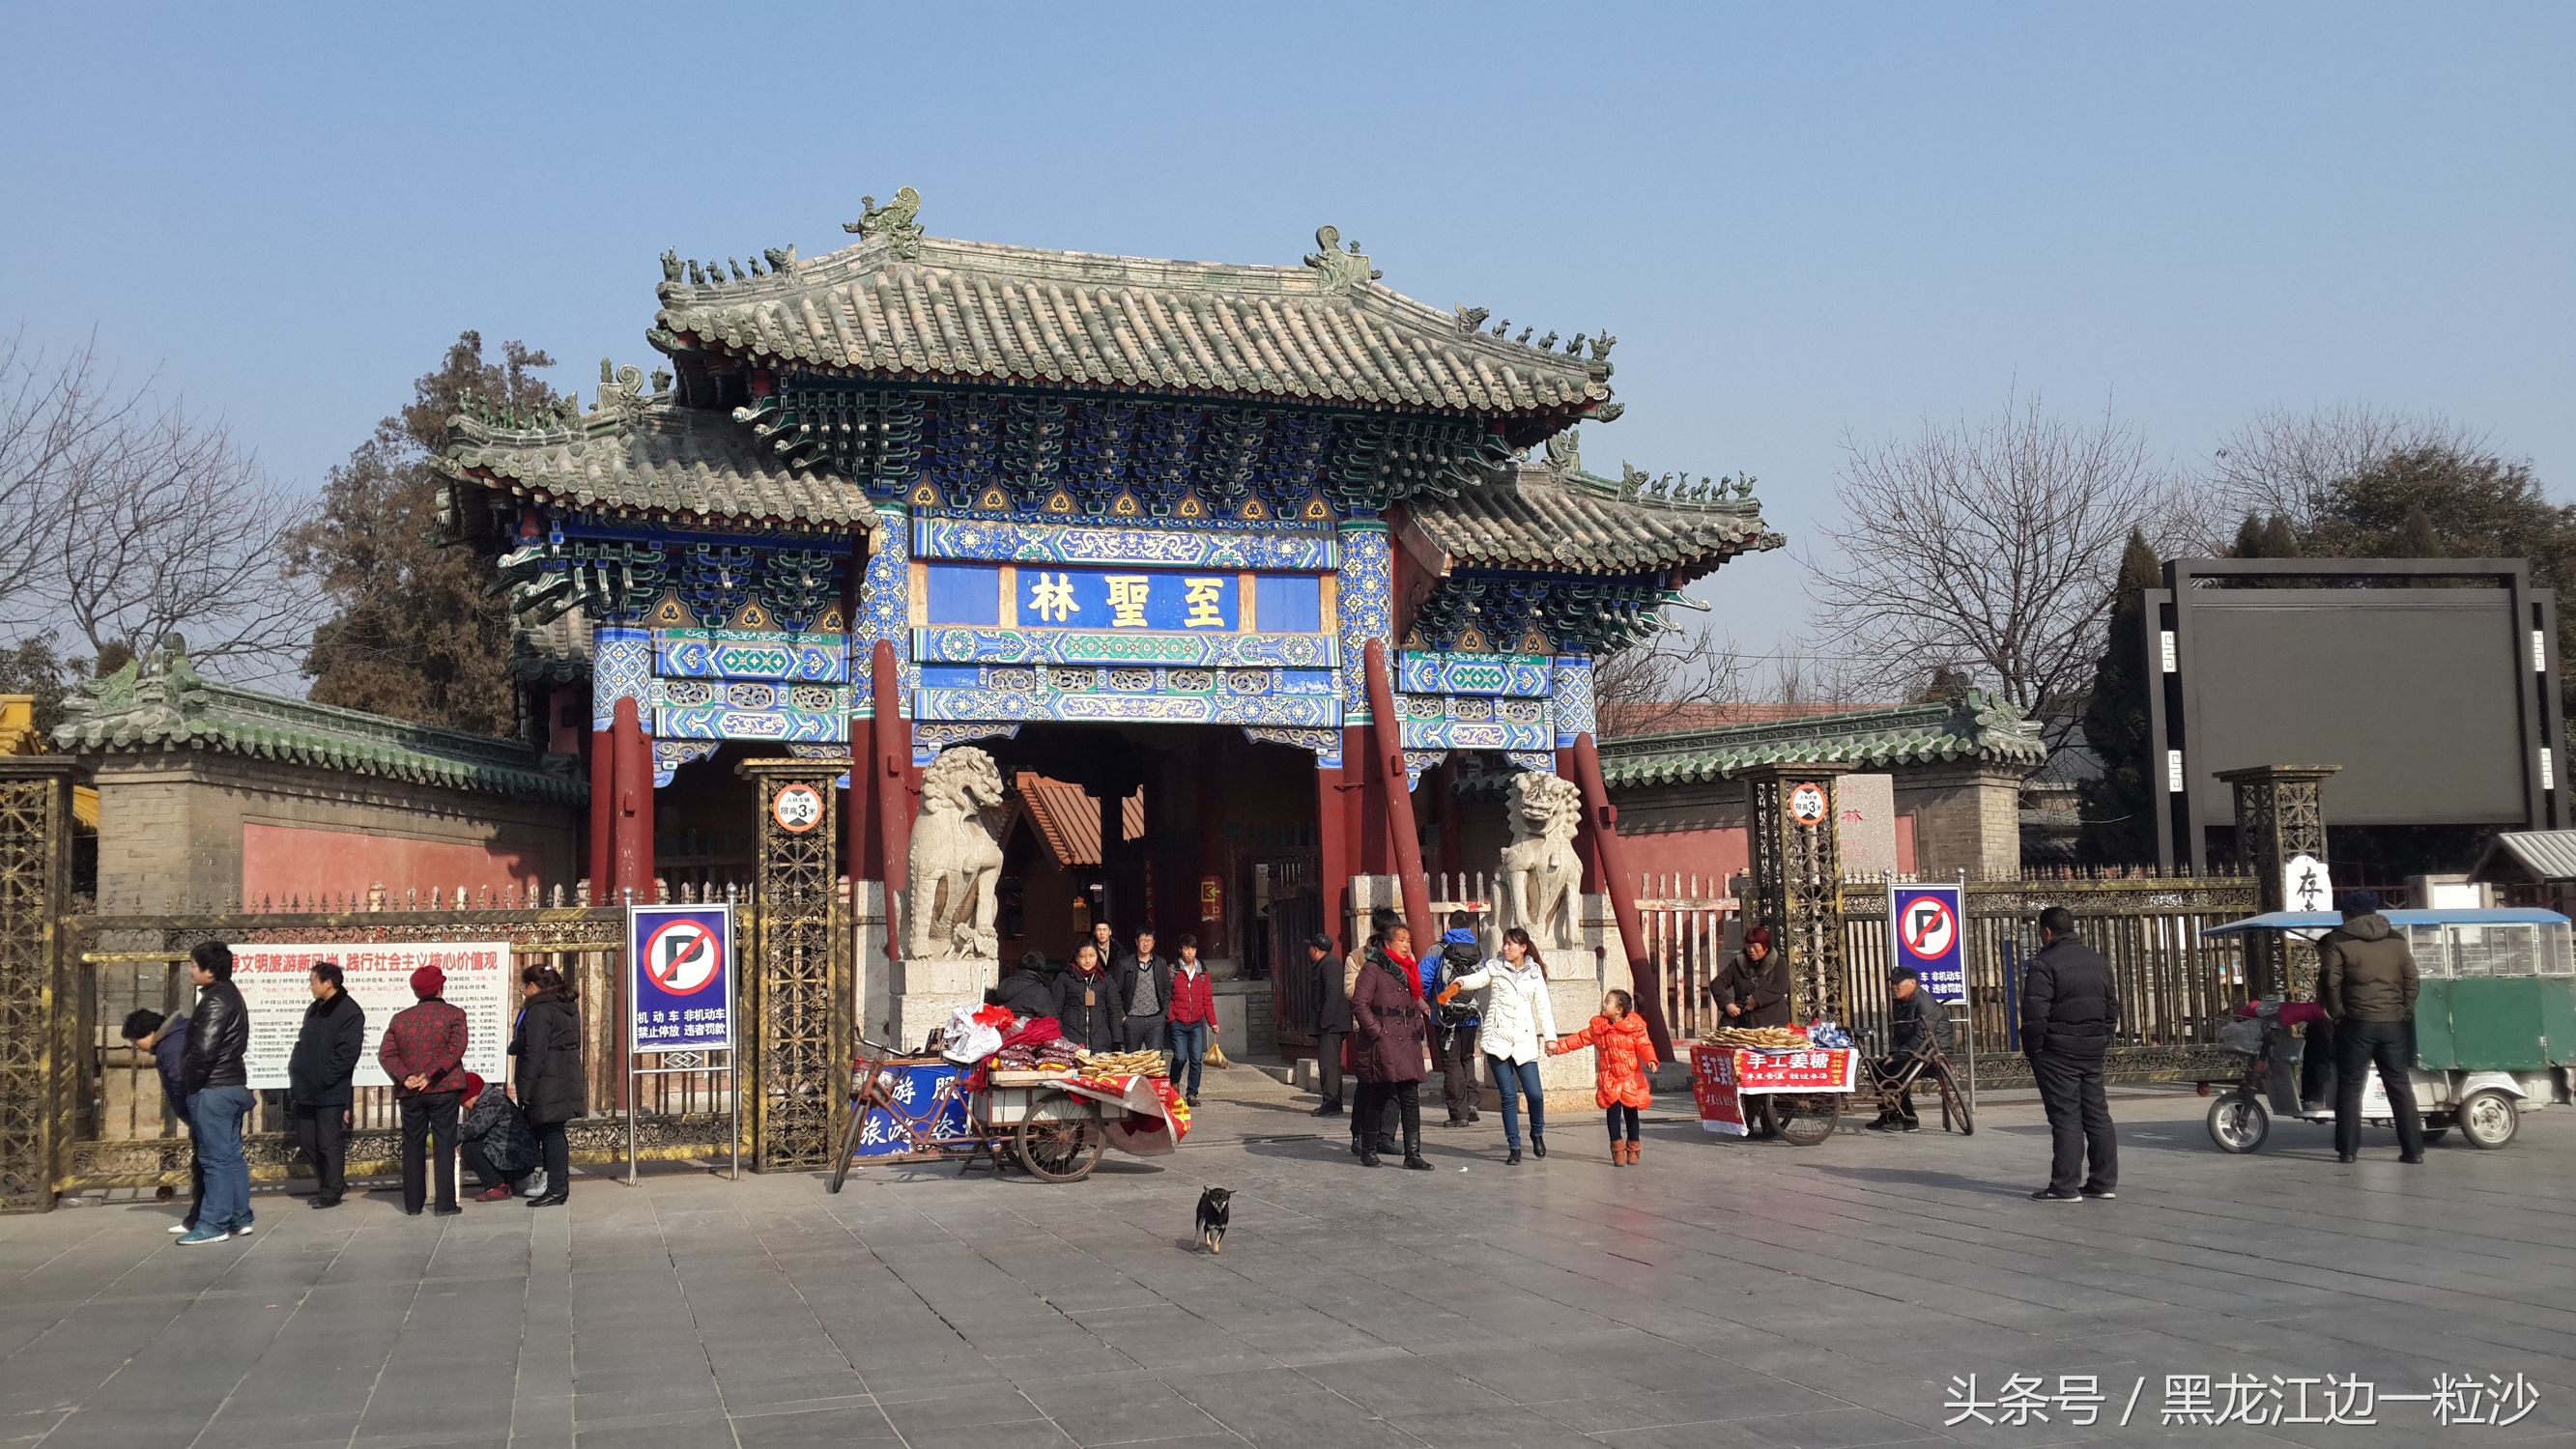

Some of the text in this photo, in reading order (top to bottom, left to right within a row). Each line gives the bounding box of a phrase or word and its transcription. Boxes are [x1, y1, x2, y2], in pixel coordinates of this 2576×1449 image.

[346, 952, 498, 972] 践行社会主义核心价值观
[638, 1009, 726, 1024] 机动车 非机动车
[638, 1023, 726, 1038] 禁止停放 违者罚款
[1747, 1053, 1829, 1069] 手工姜糖
